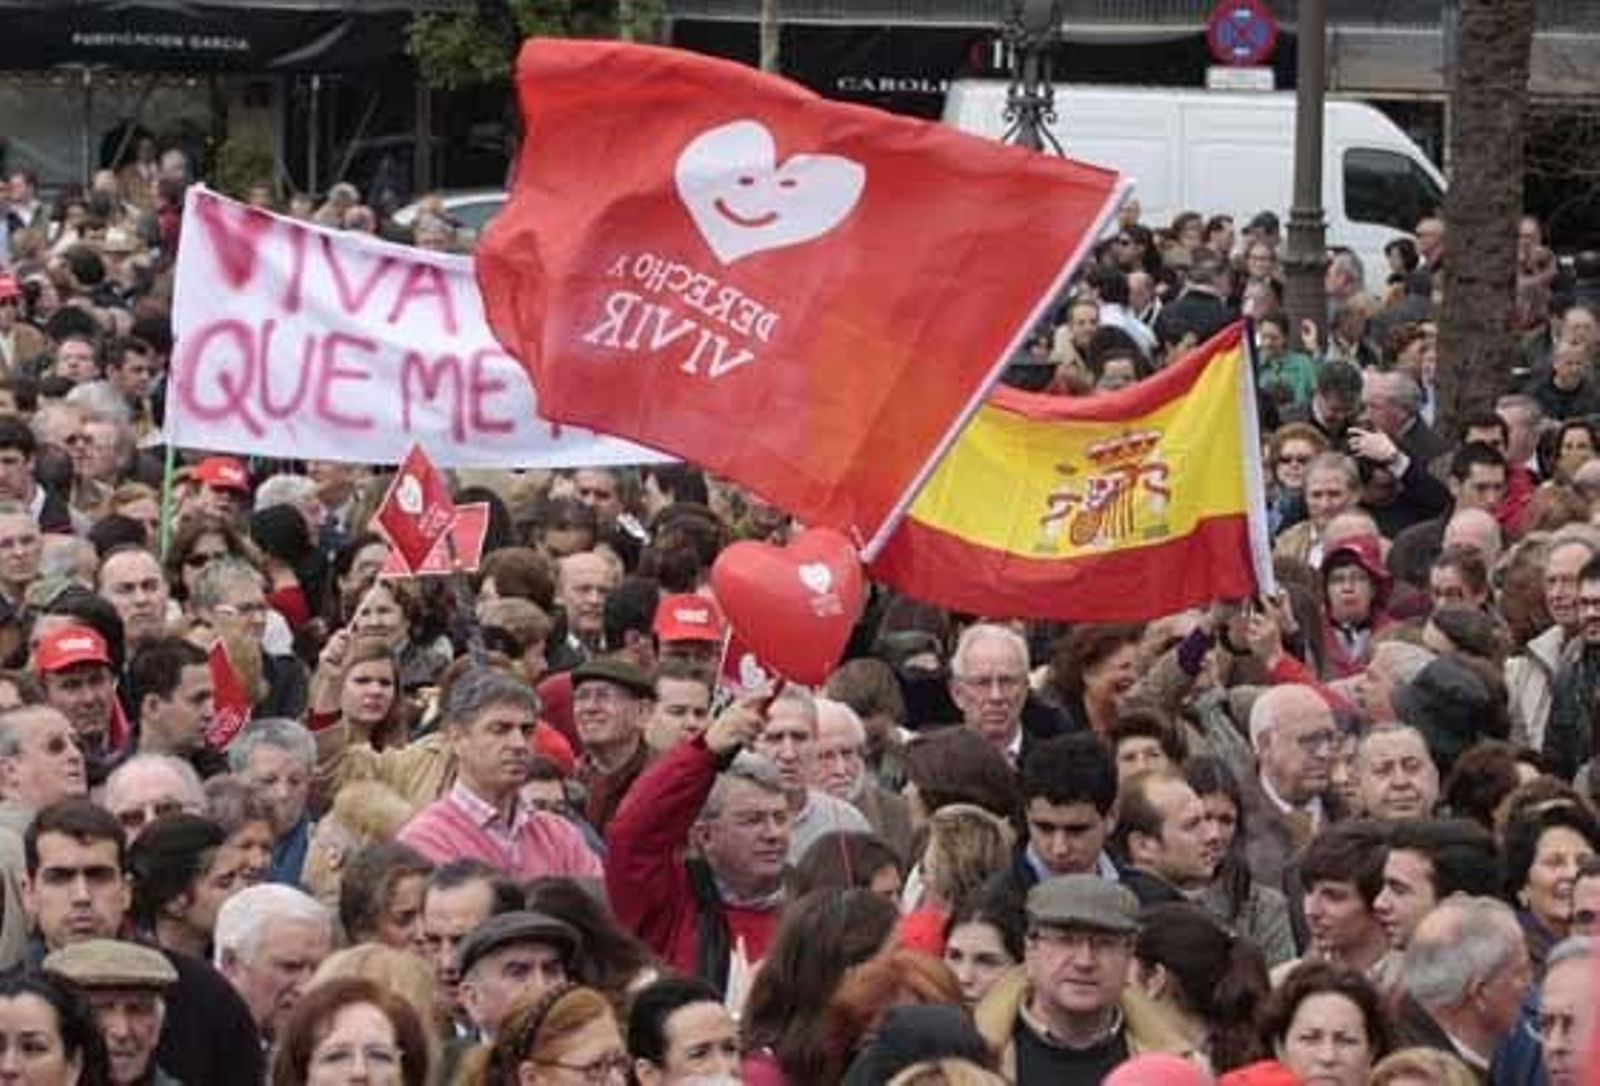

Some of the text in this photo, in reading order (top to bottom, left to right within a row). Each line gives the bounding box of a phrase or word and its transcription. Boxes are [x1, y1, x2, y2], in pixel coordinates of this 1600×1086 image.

[195, 194, 457, 335] VIVA
[180, 317, 516, 442] QUE ME
